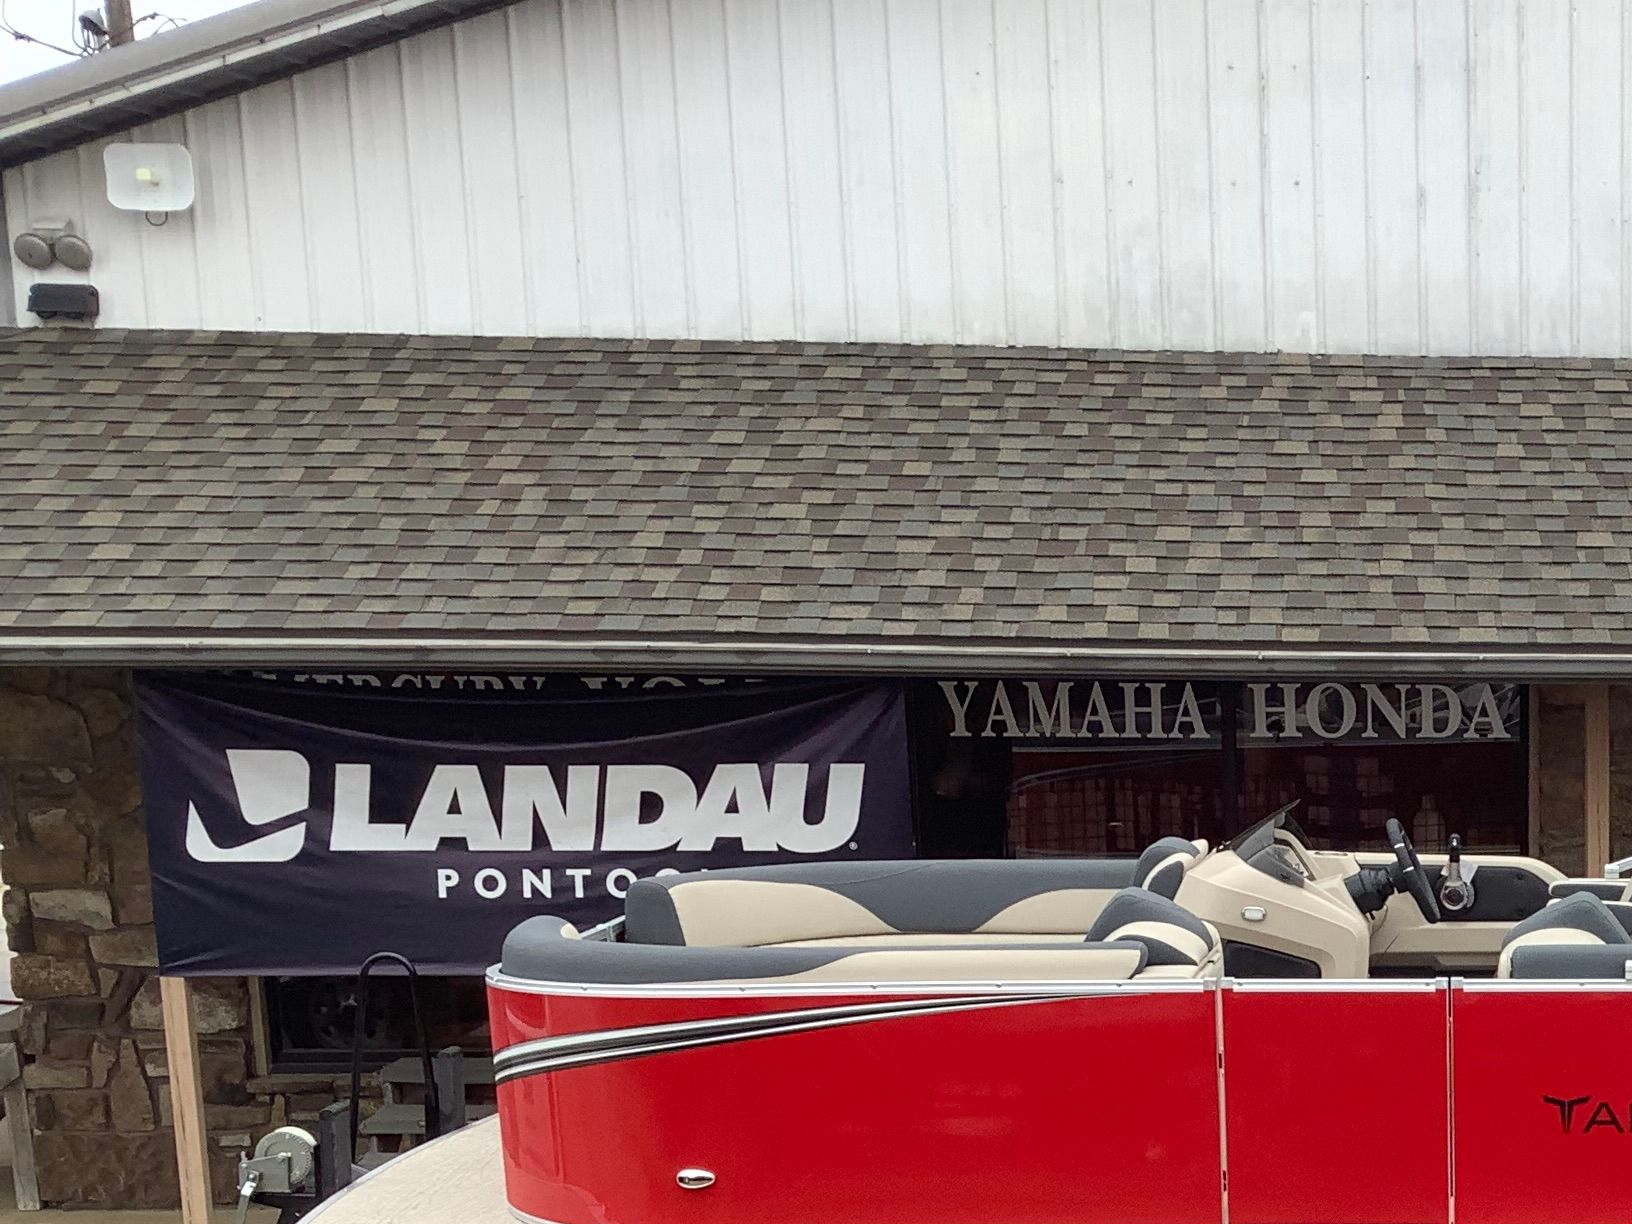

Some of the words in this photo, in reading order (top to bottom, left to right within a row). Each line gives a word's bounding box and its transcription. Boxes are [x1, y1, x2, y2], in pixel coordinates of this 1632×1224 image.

[938, 680, 1210, 739] YAMAHA
[1247, 682, 1511, 739] HONDA
[328, 762, 866, 853] LANDAU
[436, 867, 706, 899] PONTO
